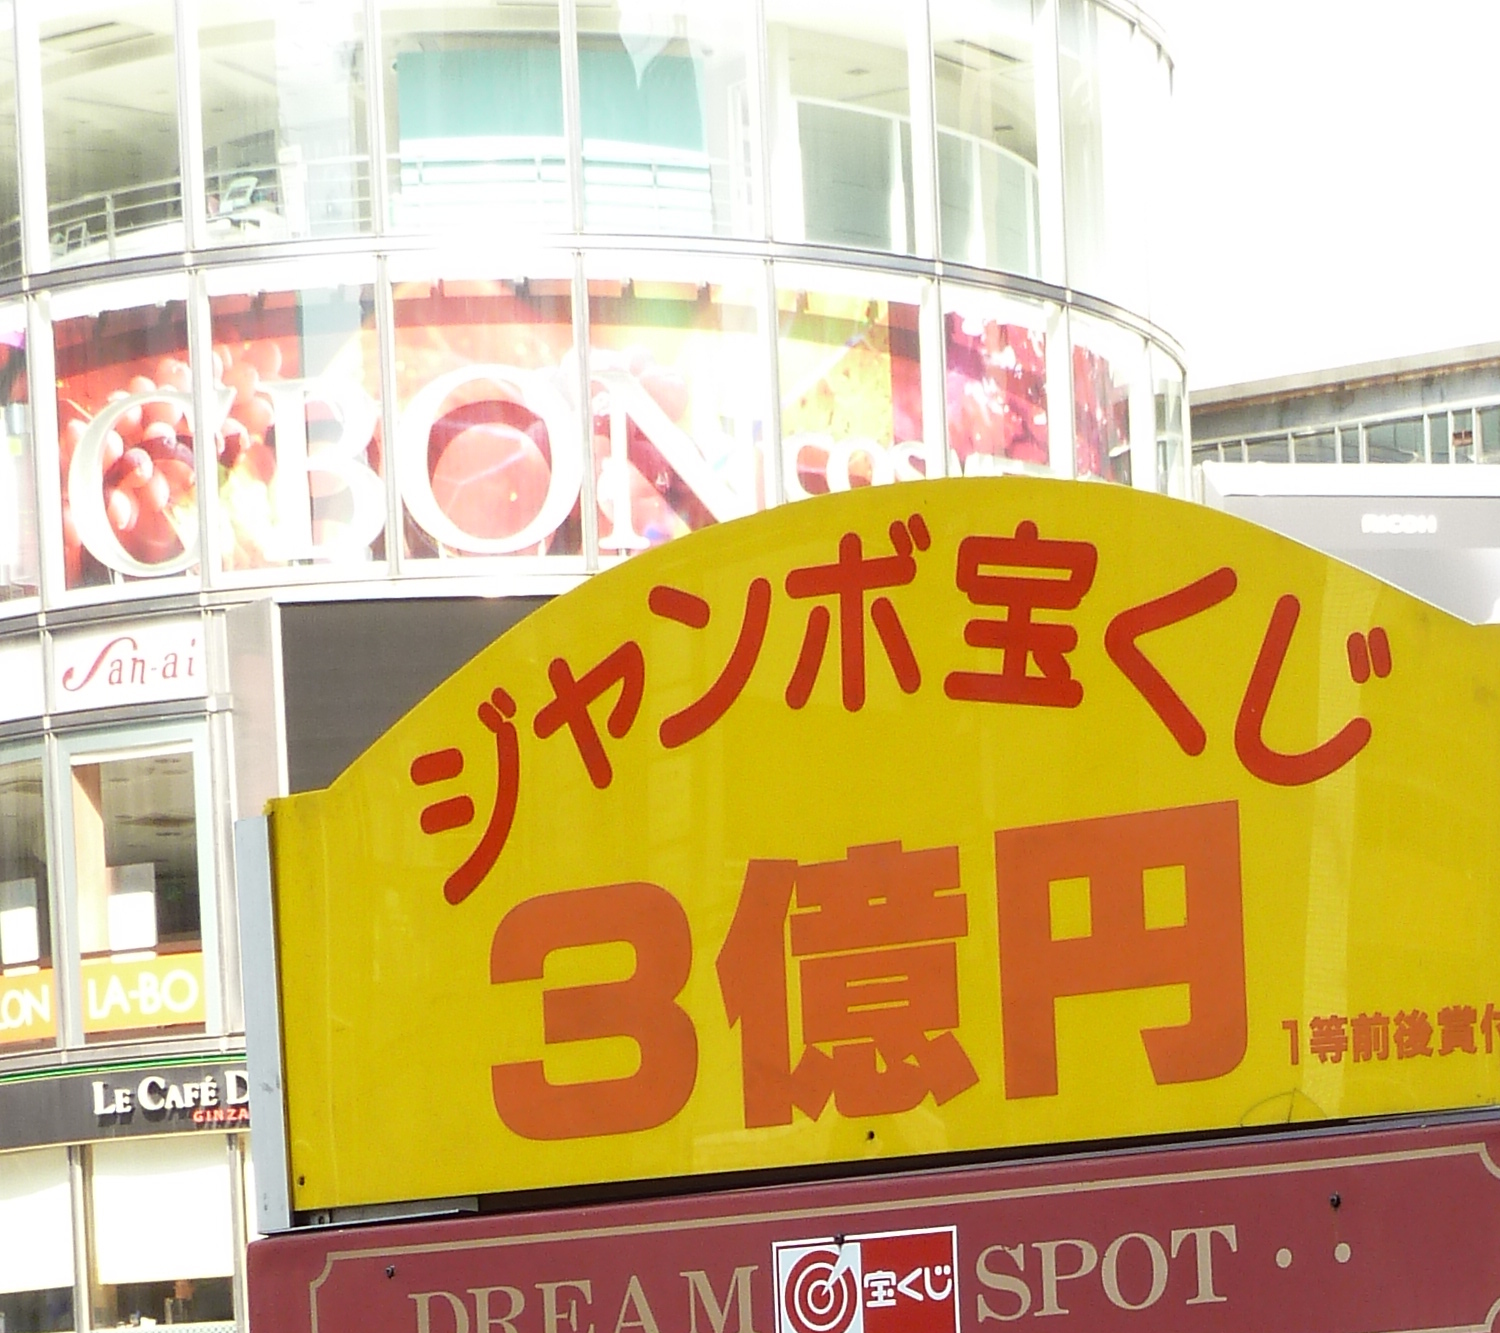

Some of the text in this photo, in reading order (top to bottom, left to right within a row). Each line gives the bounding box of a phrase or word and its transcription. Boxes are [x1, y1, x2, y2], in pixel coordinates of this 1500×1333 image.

[62, 636, 196, 692] San-ai
[409, 513, 1393, 905] ジャンボ宝くじ
[489, 800, 1249, 1142] 3億円
[863, 1265, 955, 1310] 宝くじ
[975, 1224, 1238, 1324] SPOT
